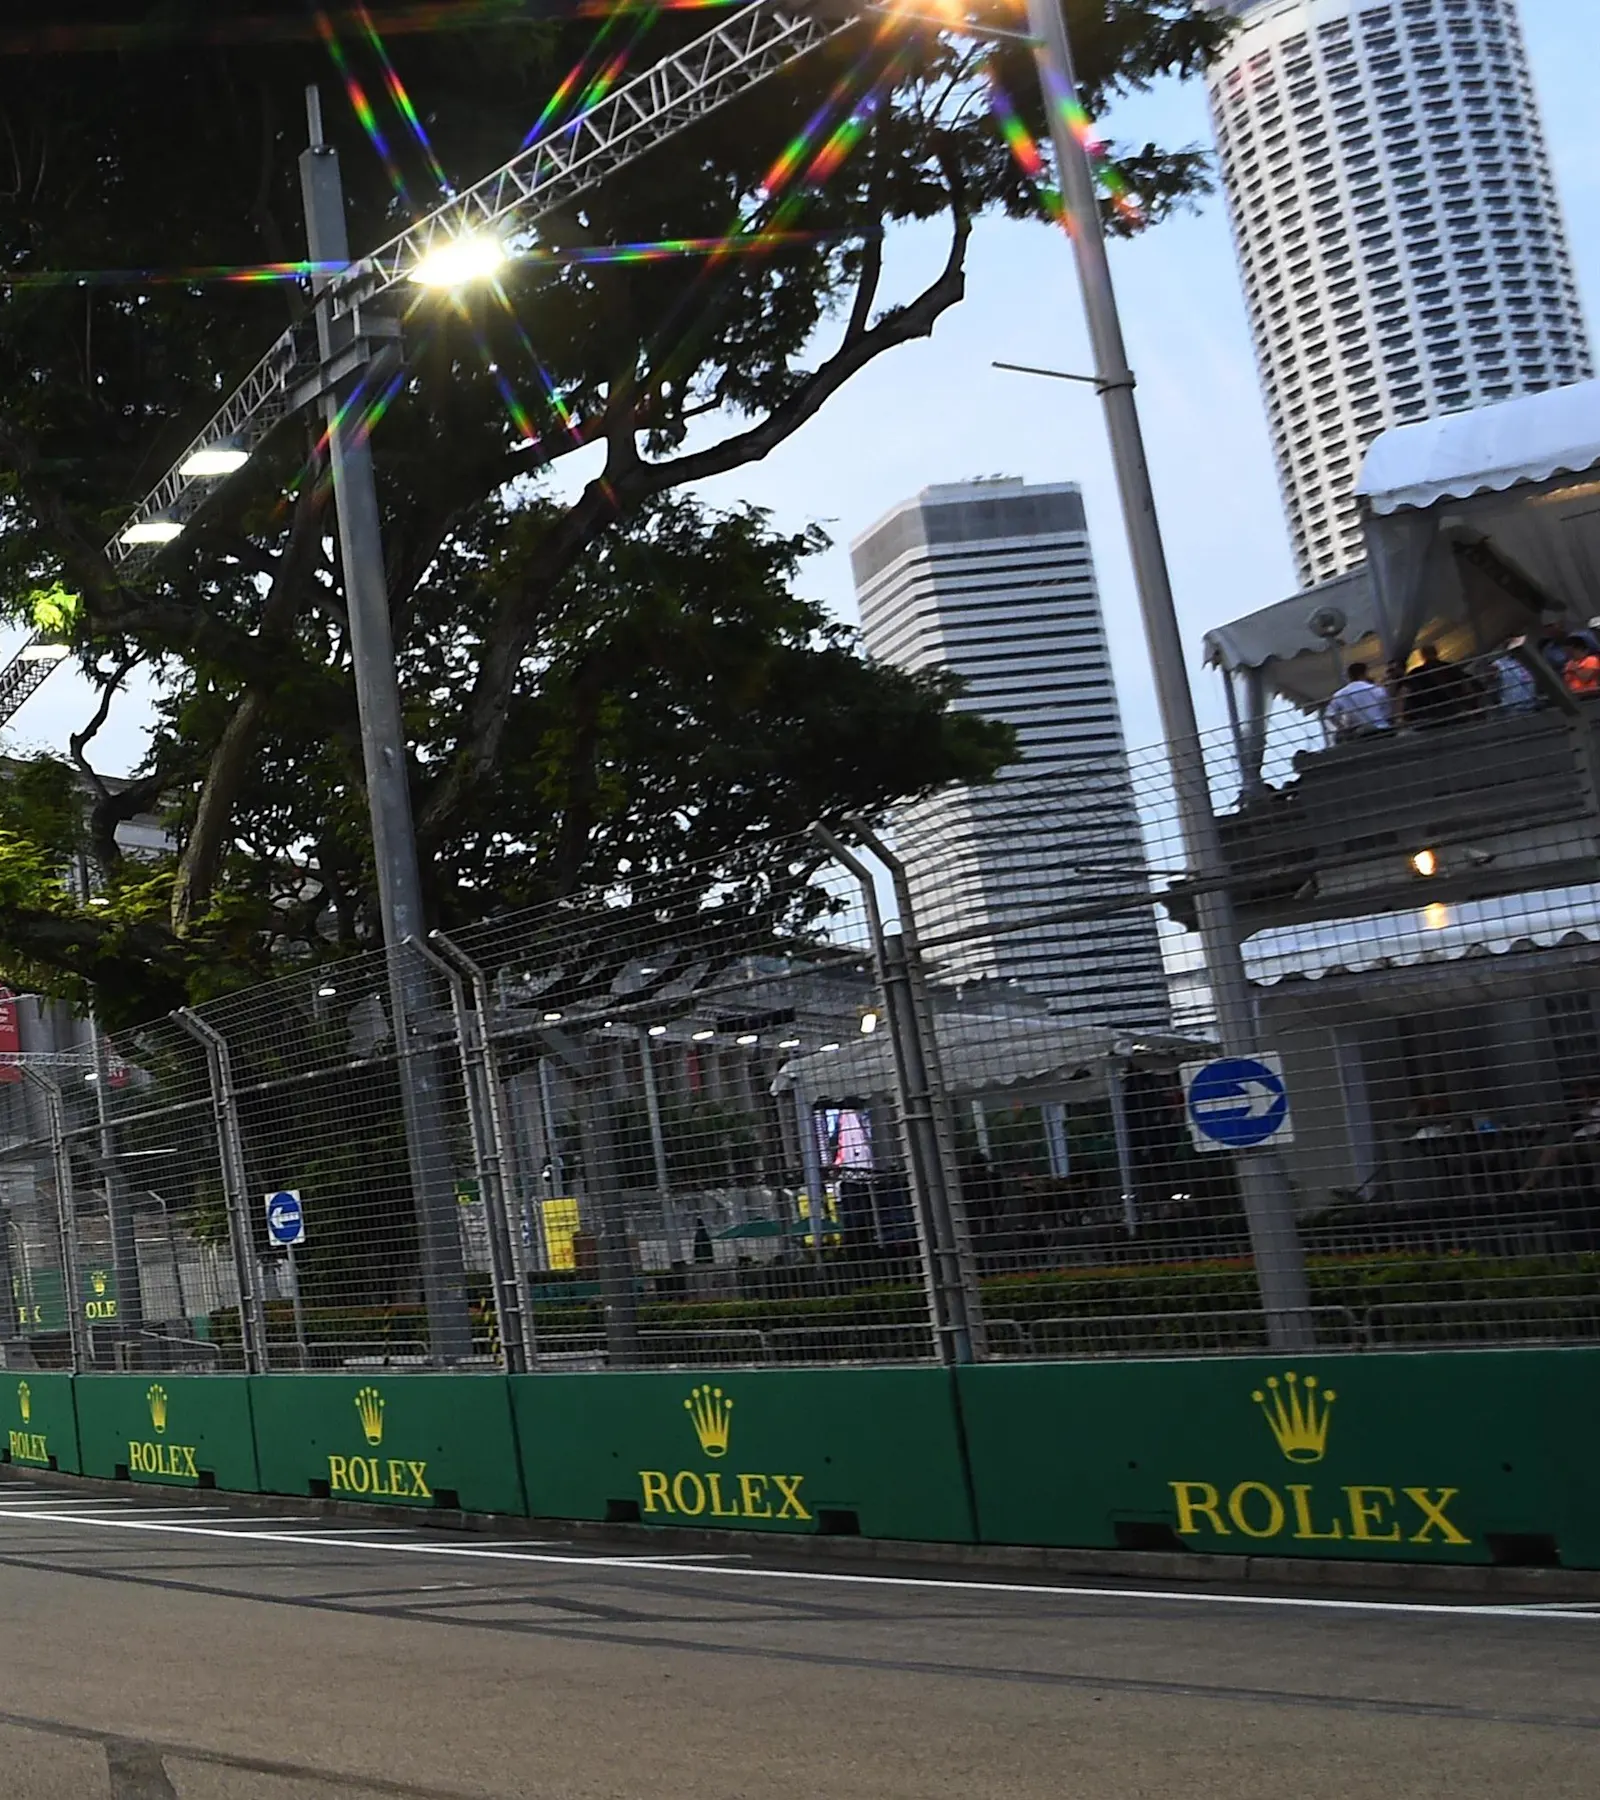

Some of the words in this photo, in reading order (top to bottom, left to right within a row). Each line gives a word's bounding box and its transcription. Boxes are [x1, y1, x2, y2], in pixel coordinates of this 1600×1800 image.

[85, 1301, 117, 1318] OLE
[9, 1430, 49, 1462] ROLEX
[128, 1441, 199, 1478] ROLEX
[328, 1455, 433, 1498] ROLEX
[638, 1470, 812, 1520] ROLEX
[1167, 1480, 1473, 1544] ROLEX
